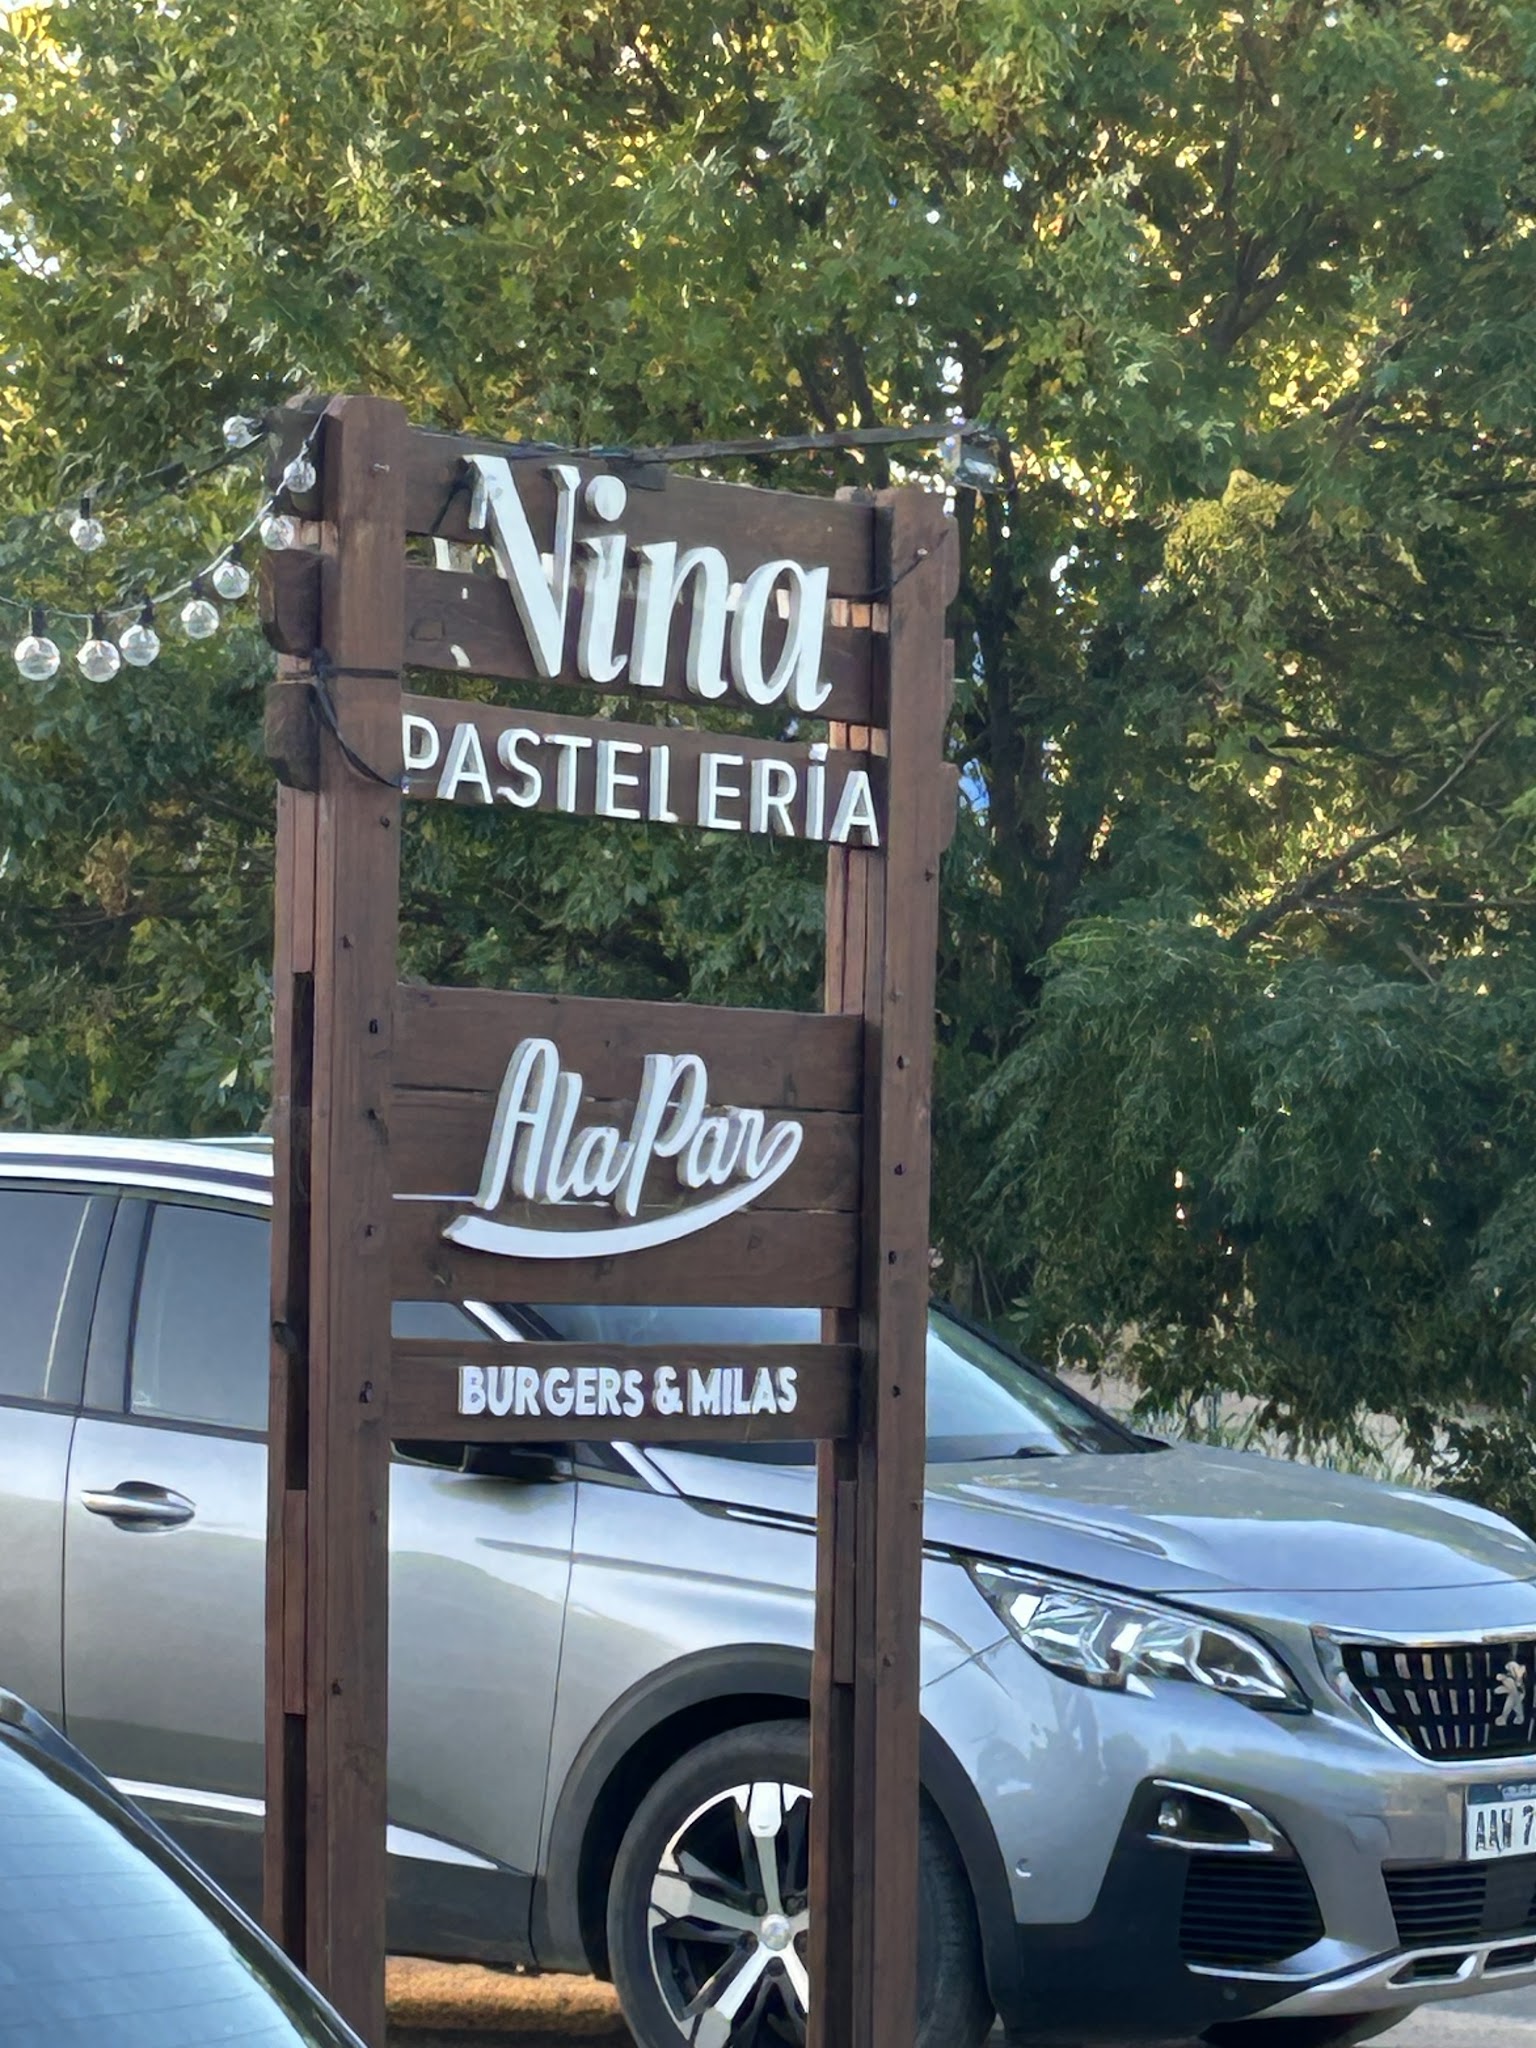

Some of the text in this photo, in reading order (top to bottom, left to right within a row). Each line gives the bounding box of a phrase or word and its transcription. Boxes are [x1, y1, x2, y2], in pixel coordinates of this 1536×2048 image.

[458, 1366, 798, 1418] BURGERS & MILAS
